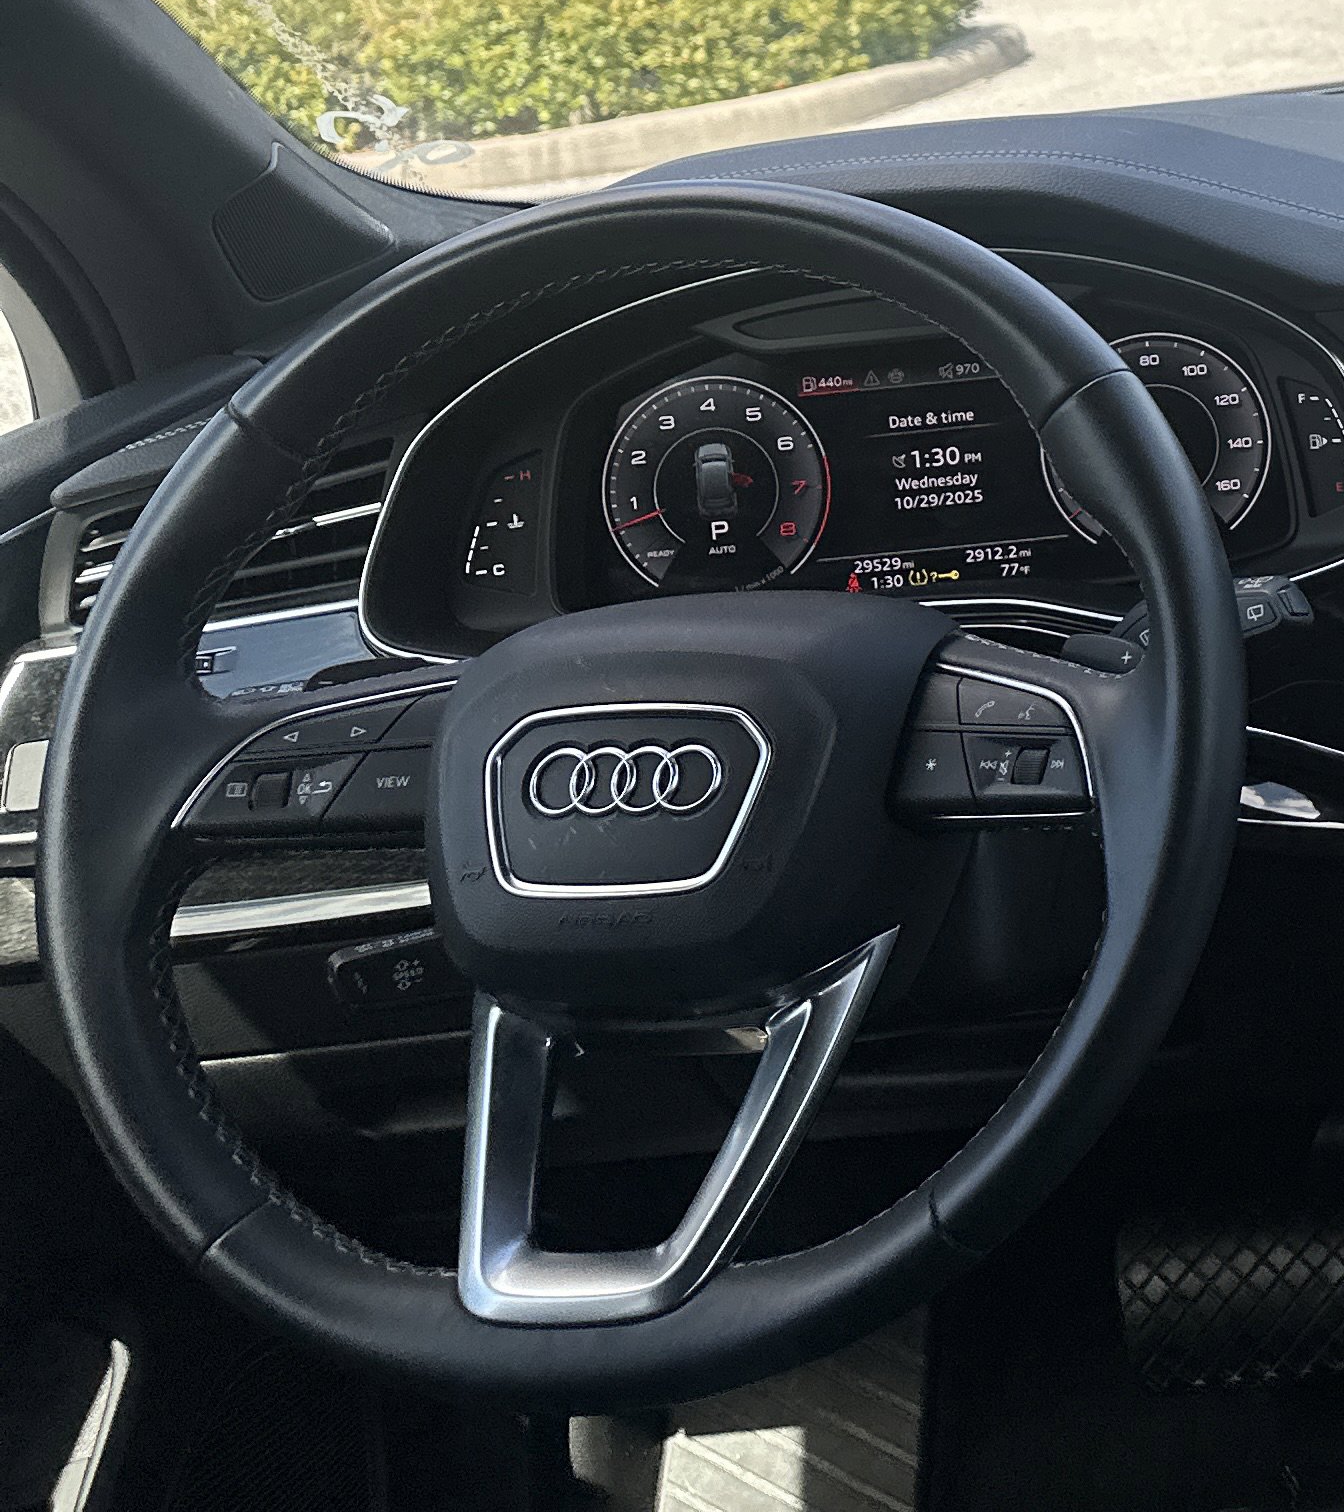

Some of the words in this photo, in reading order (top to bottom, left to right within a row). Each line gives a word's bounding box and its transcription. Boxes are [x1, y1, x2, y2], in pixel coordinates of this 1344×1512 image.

[1139, 354, 1160, 366] 80
[955, 363, 980, 376] 970
[1182, 364, 1208, 377] 100
[700, 398, 716, 411] 4
[1214, 393, 1239, 407] 120
[1297, 393, 1306, 404] F
[745, 407, 762, 421] 5
[888, 414, 922, 429] Date
[926, 411, 938, 425] &
[941, 409, 975, 424] time
[658, 415, 675, 430] 3
[777, 436, 794, 450] 6
[1227, 437, 1253, 449] 140
[631, 450, 647, 465] 2
[910, 446, 960, 469] 1:30
[965, 452, 982, 464] PM
[519, 470, 532, 481] H
[895, 472, 979, 491] Wednesday
[791, 480, 806, 495] 7
[1215, 478, 1241, 491] 160
[629, 496, 638, 510] 1
[895, 489, 984, 511] 10/29/2025
[710, 521, 729, 540] P
[780, 522, 796, 536] 8
[647, 548, 675, 558] READY
[708, 544, 736, 555] AUTO
[492, 563, 505, 576] C
[871, 575, 904, 589] 1:30
[297, 782, 312, 794] OK
[376, 775, 411, 789] VIEW
